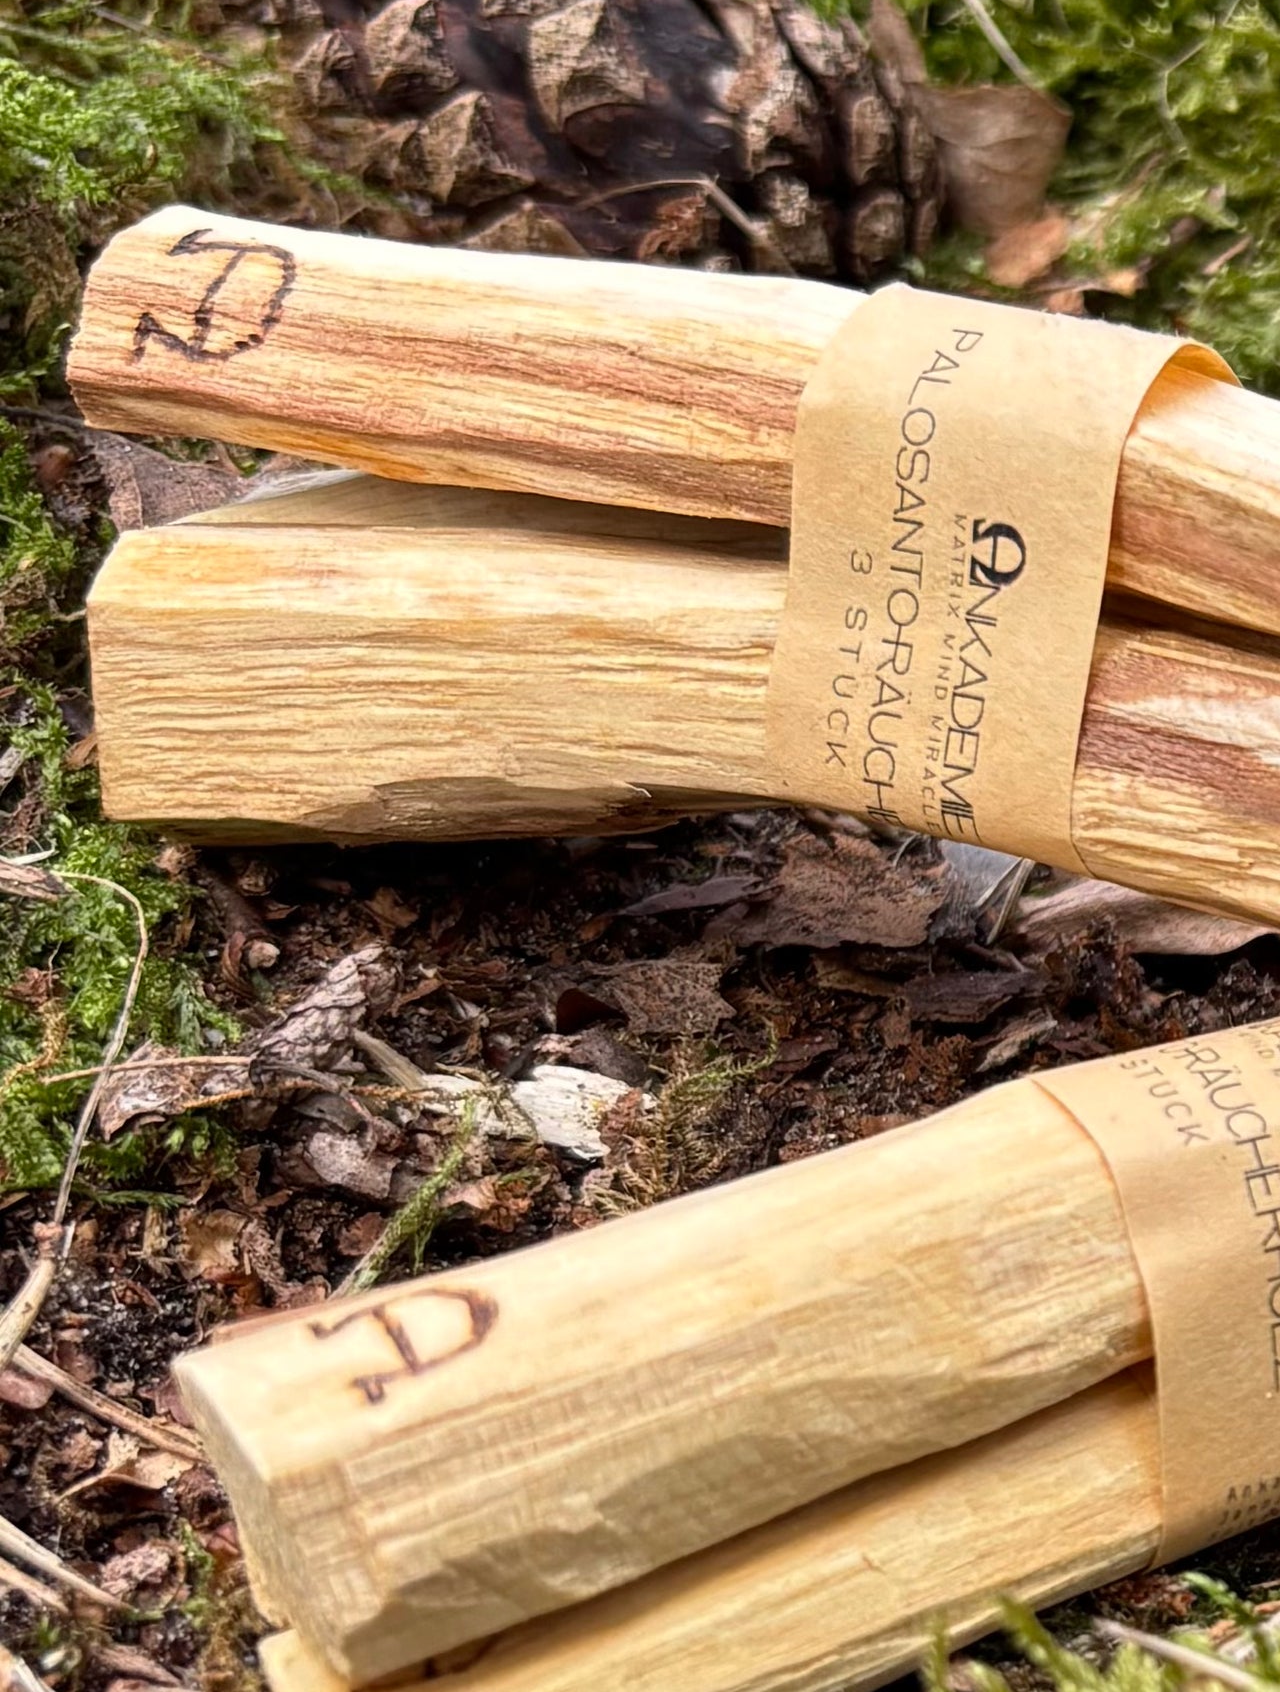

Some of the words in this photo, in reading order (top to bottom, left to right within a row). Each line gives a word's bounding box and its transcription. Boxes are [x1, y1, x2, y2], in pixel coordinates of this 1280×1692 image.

[850, 549, 873, 575] 3
[947, 513, 968, 619] MATRIX
[934, 633, 956, 700] MIND
[921, 714, 945, 834] MIRACLE
